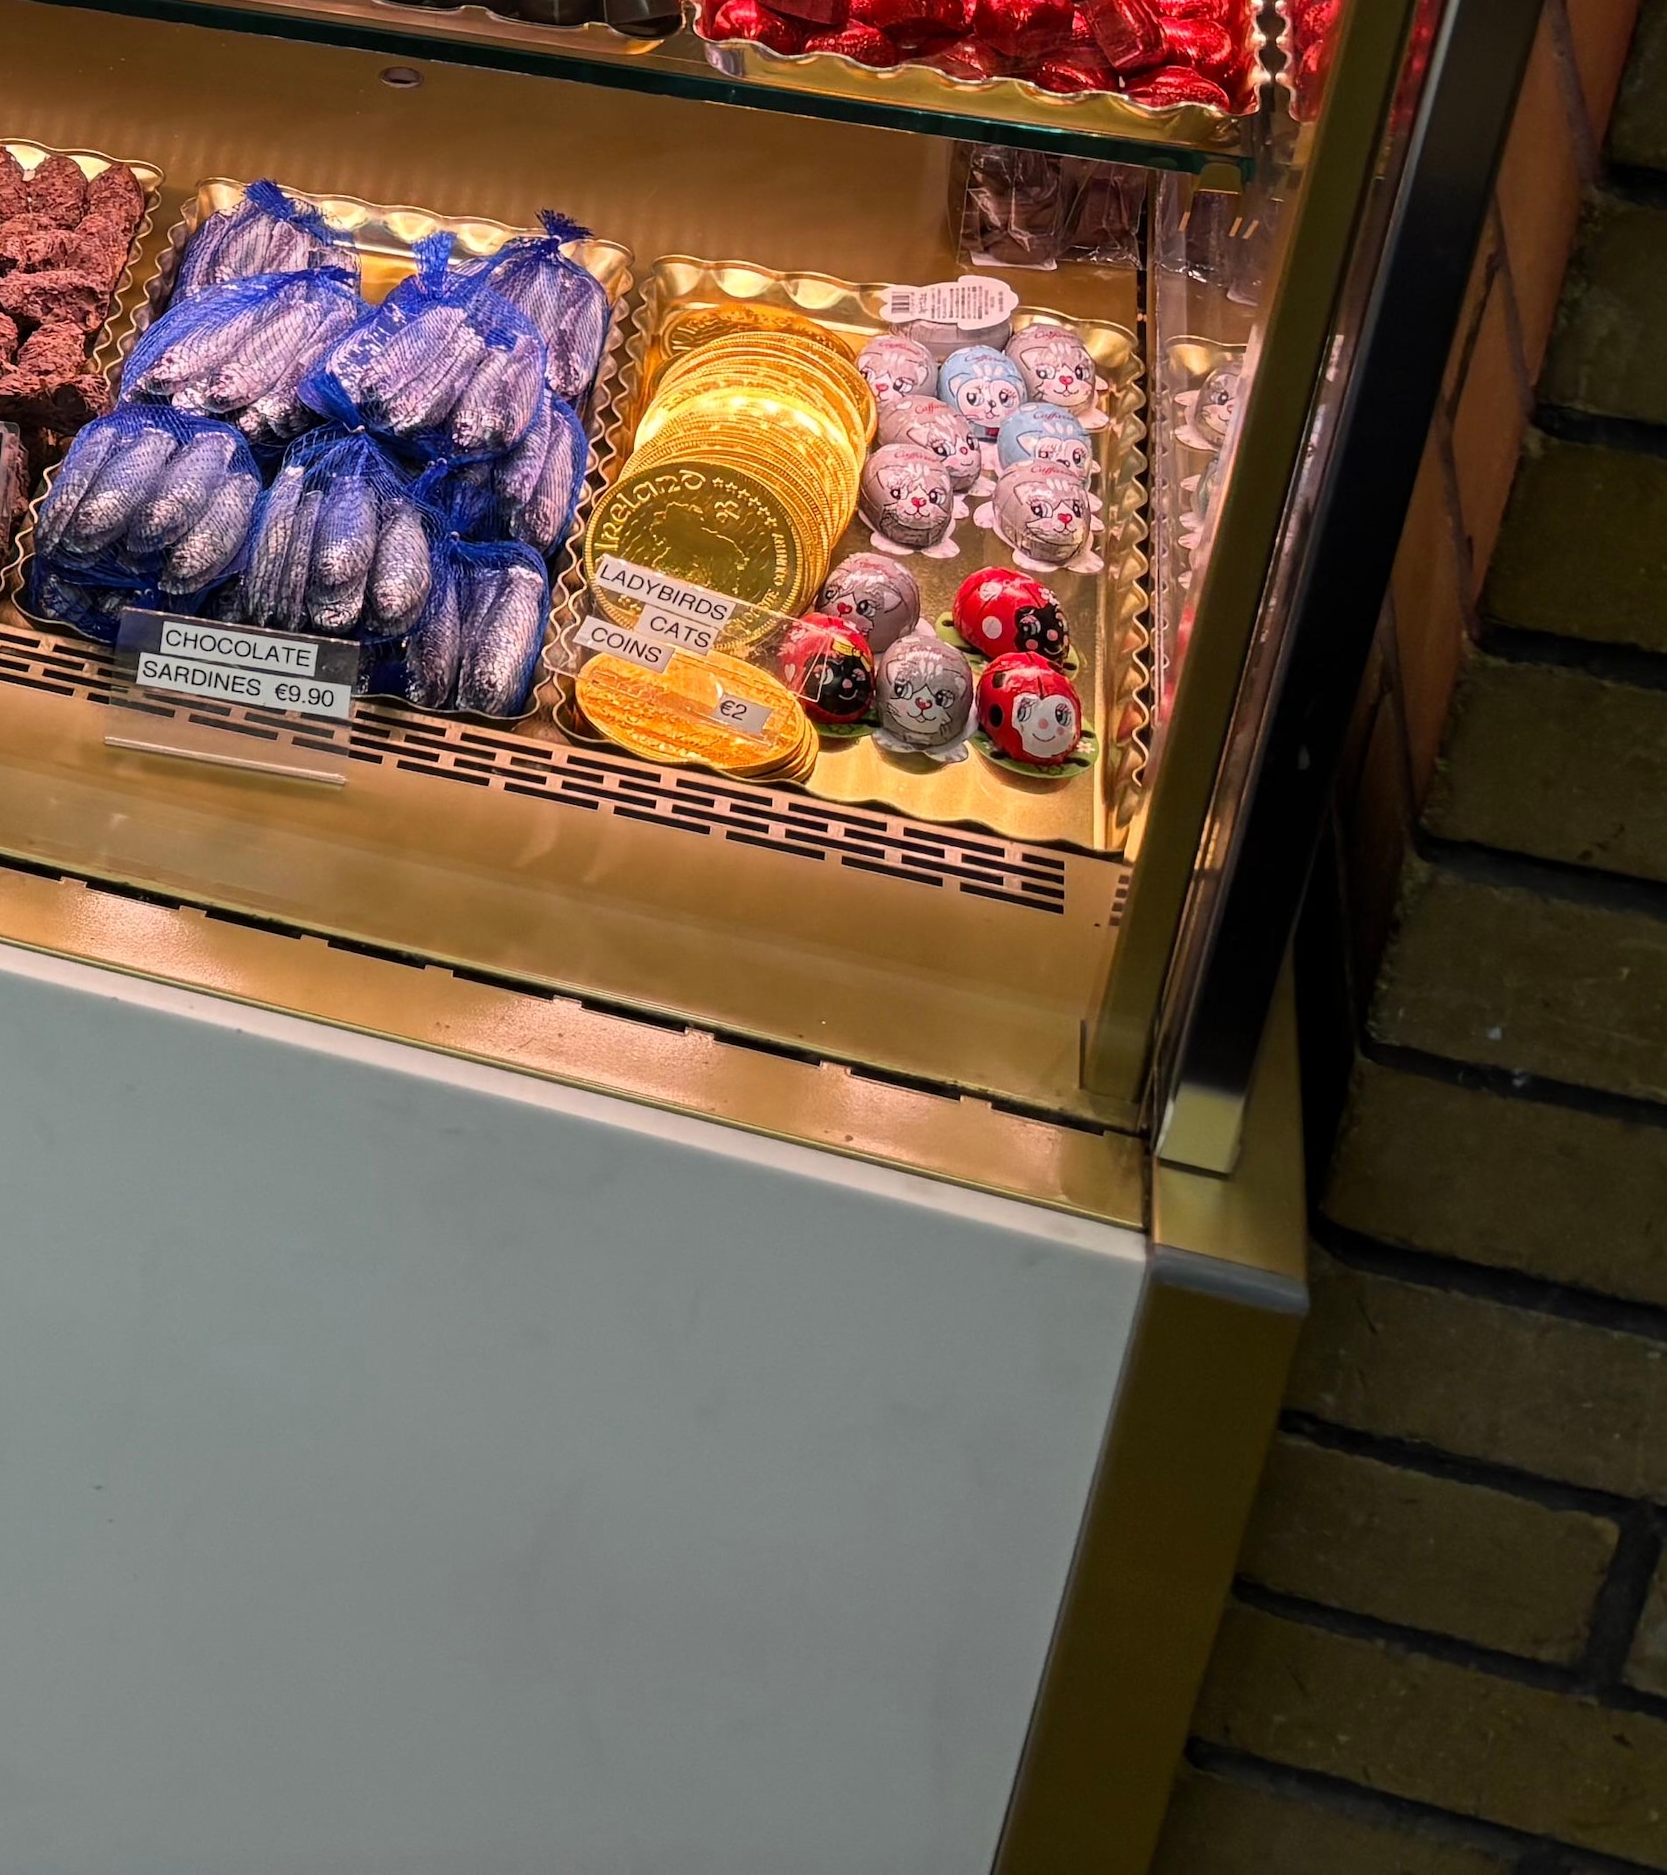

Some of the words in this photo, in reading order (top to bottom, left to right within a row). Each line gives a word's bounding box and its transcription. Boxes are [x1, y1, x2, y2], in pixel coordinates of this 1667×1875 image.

[599, 563, 730, 622] LADYBIRDS
[165, 629, 312, 668] CHOCOLATE
[590, 627, 663, 664] COINS
[649, 616, 712, 649] CATS
[141, 660, 263, 697] SARDINES
[274, 682, 336, 709] €9.90
[719, 699, 748, 722] €2
